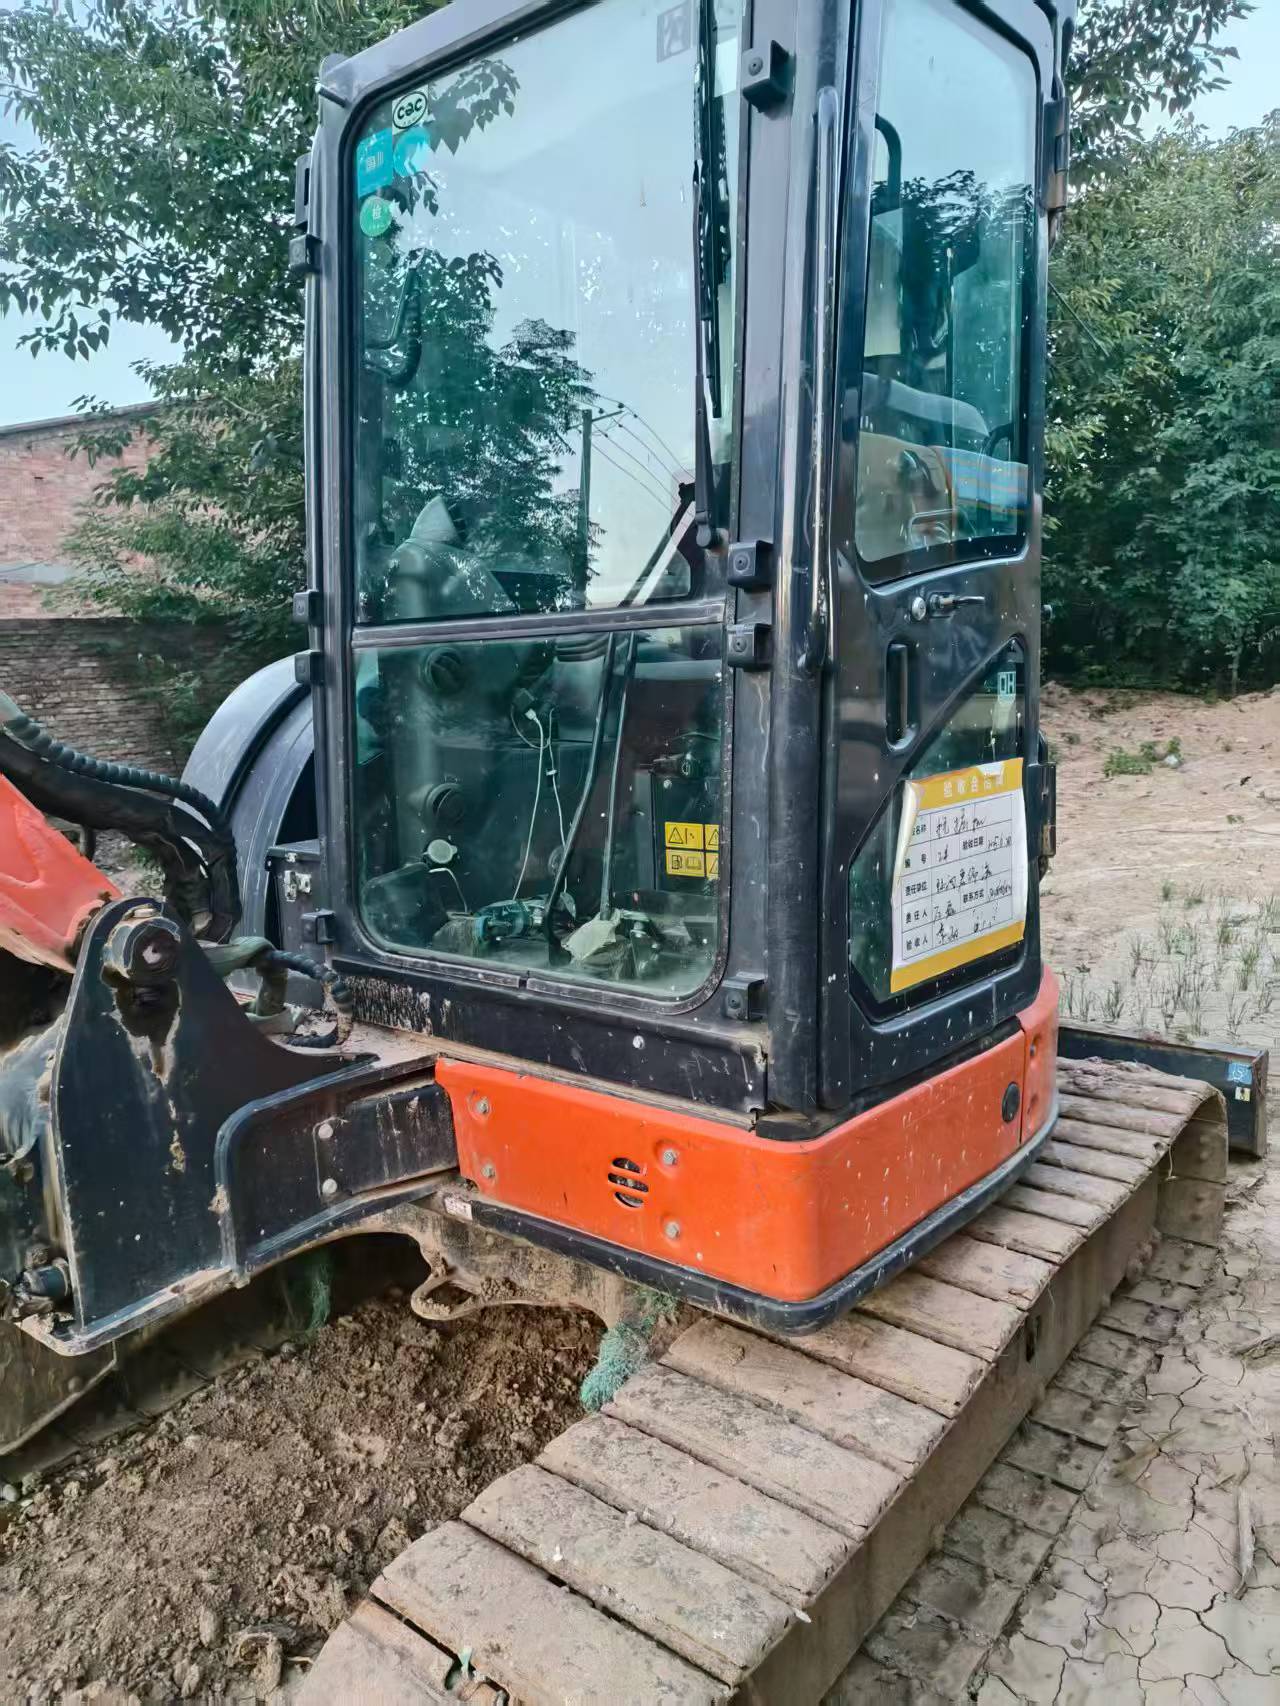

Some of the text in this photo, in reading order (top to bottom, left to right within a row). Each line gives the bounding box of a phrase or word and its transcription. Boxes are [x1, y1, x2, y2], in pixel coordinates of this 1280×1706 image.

[905, 880, 928, 896] 责任单位
[962, 887, 984, 904] 联系方式
